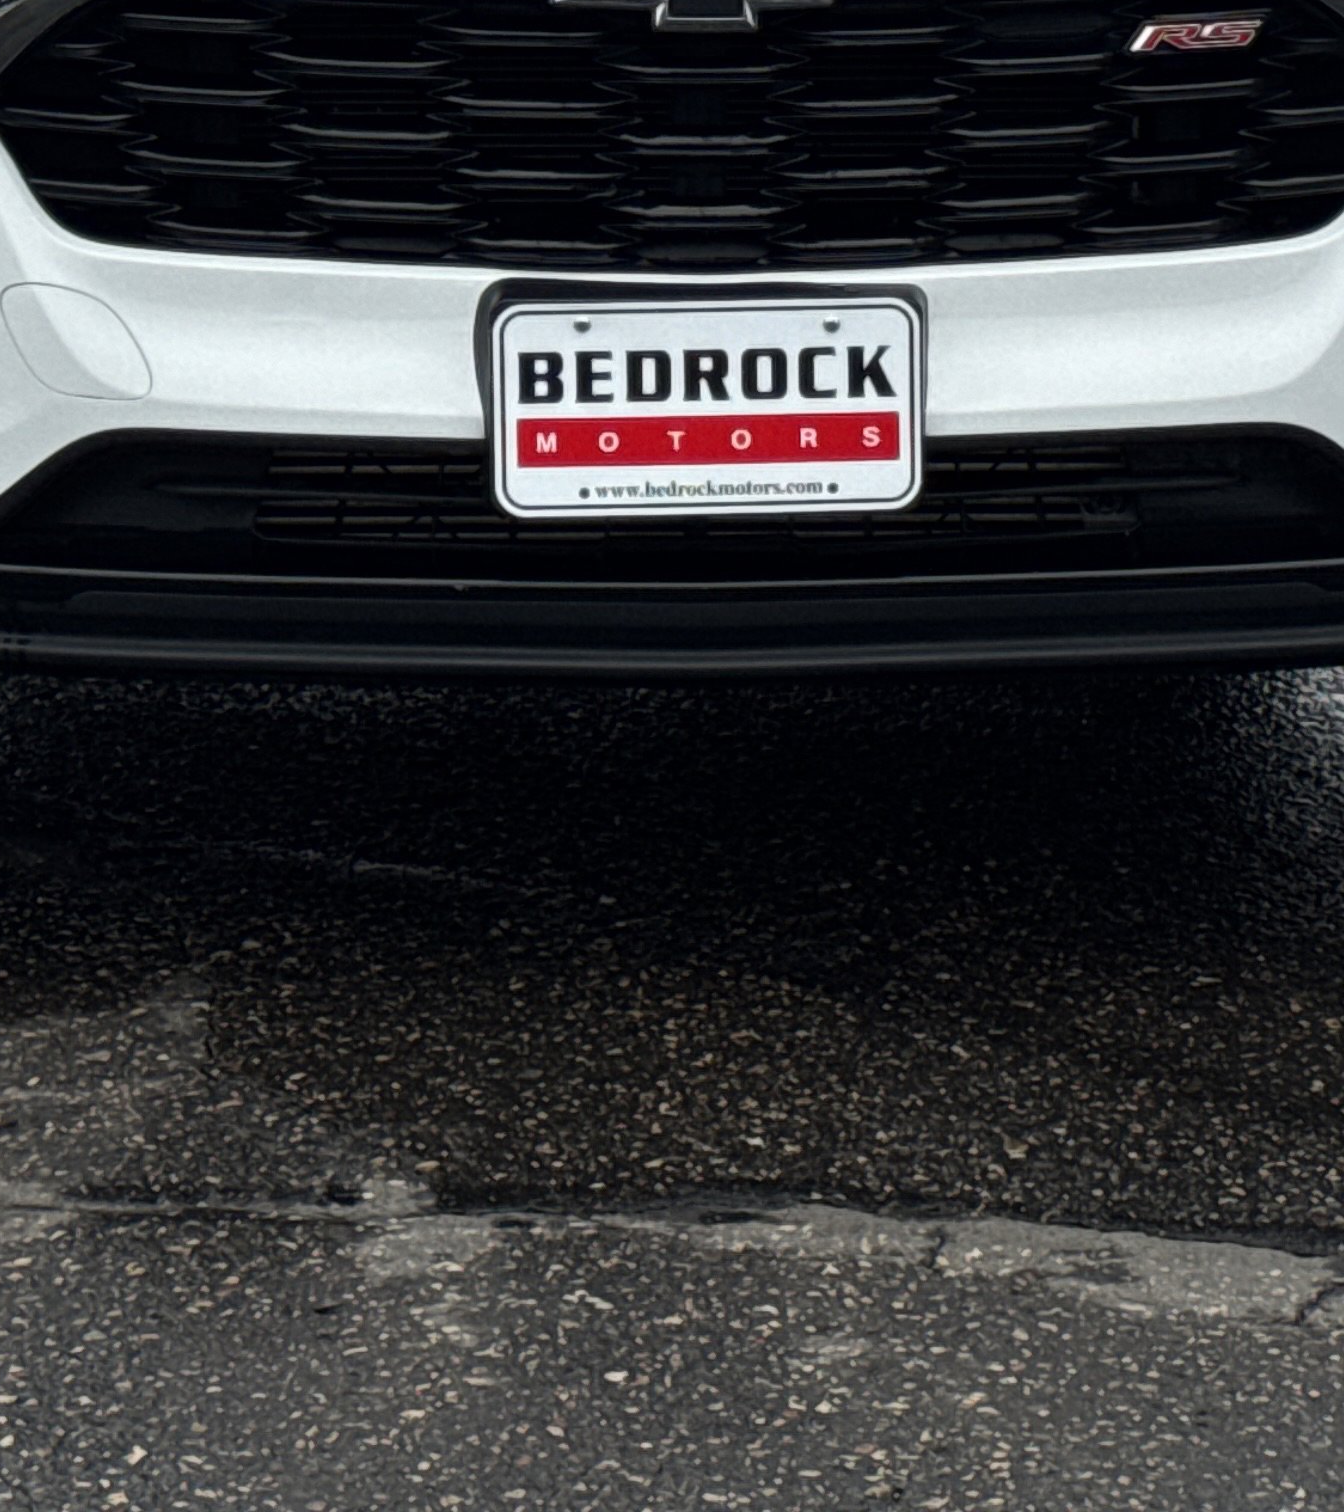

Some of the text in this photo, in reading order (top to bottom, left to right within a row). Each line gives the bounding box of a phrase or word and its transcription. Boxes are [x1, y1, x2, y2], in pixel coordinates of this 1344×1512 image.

[1129, 18, 1263, 52] RS
[517, 345, 898, 404] BEDROCK
[535, 425, 882, 455] MOTORS
[594, 480, 824, 500] www.bedrockmotors.com
